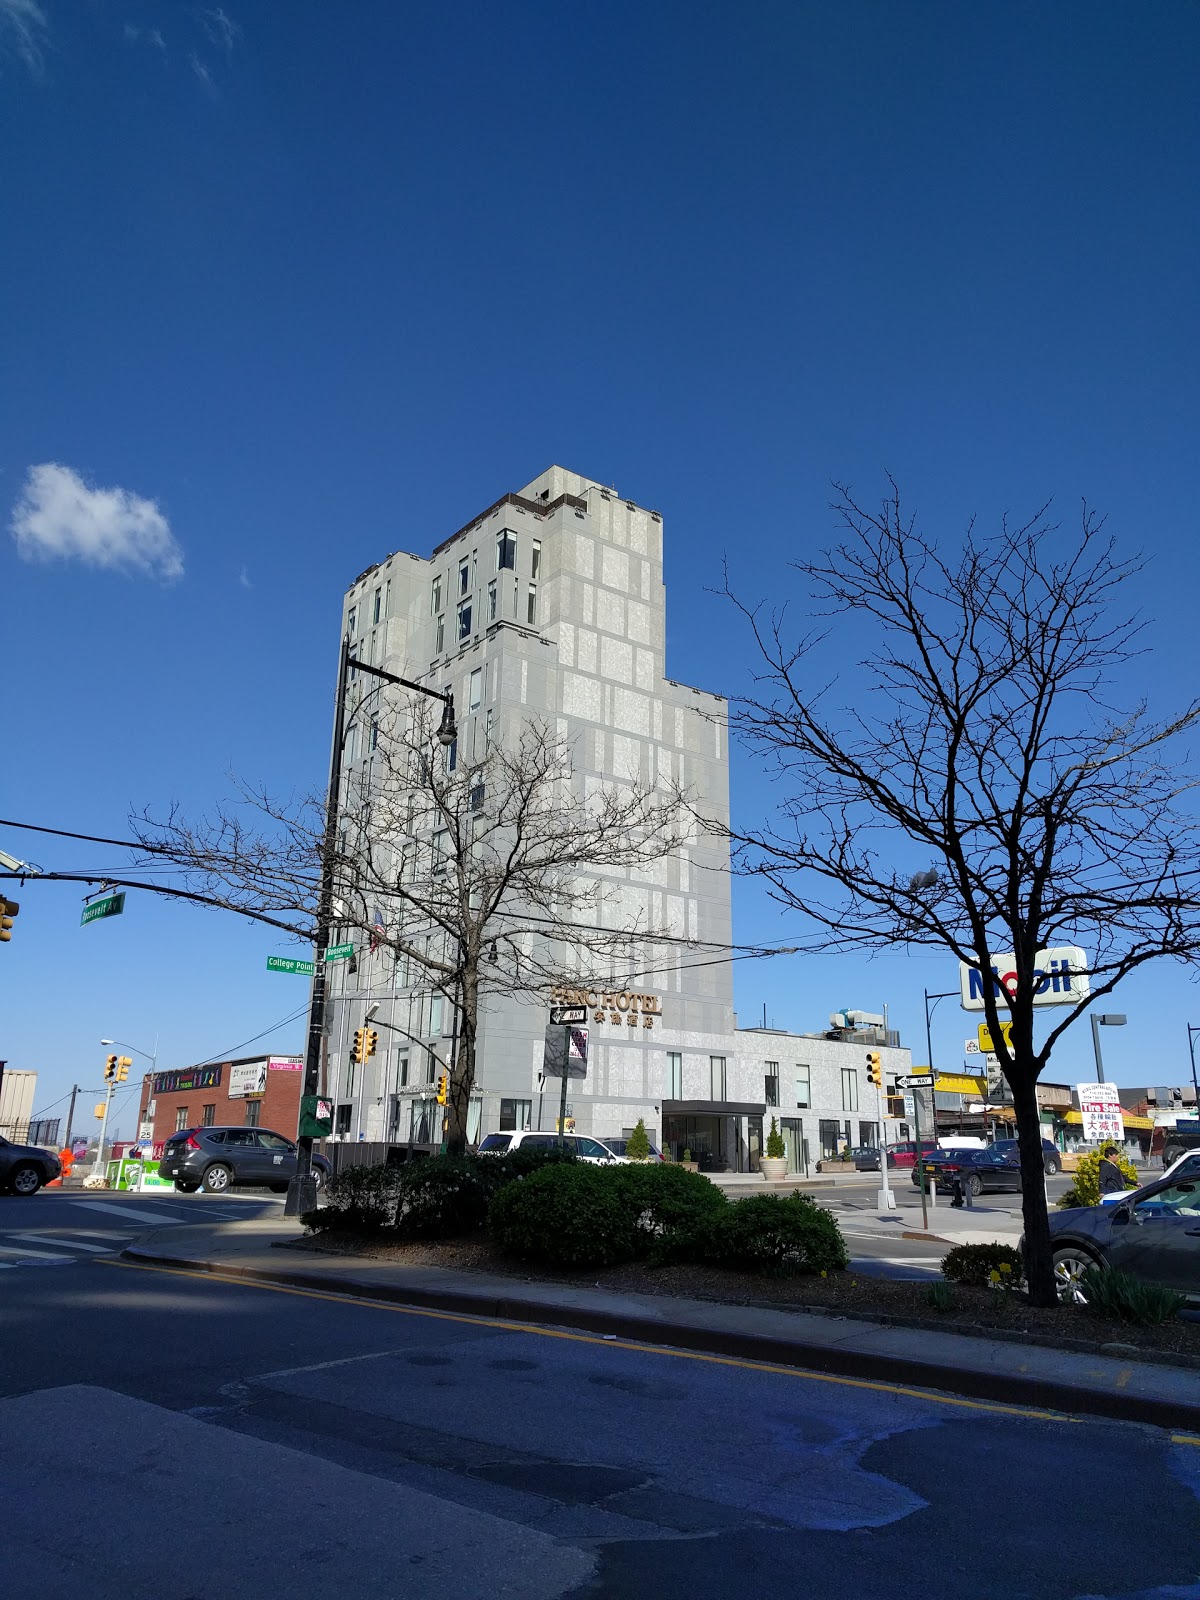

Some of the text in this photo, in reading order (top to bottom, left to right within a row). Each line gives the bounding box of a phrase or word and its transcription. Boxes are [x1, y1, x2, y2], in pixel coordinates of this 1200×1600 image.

[328, 945, 352, 956] Roosevelt
[268, 957, 313, 971] College Point
[601, 991, 662, 1016] HOTEL
[569, 1011, 582, 1020] WAY
[1082, 1103, 1120, 1113] Tire Sale
[141, 1131, 151, 1139] 25
